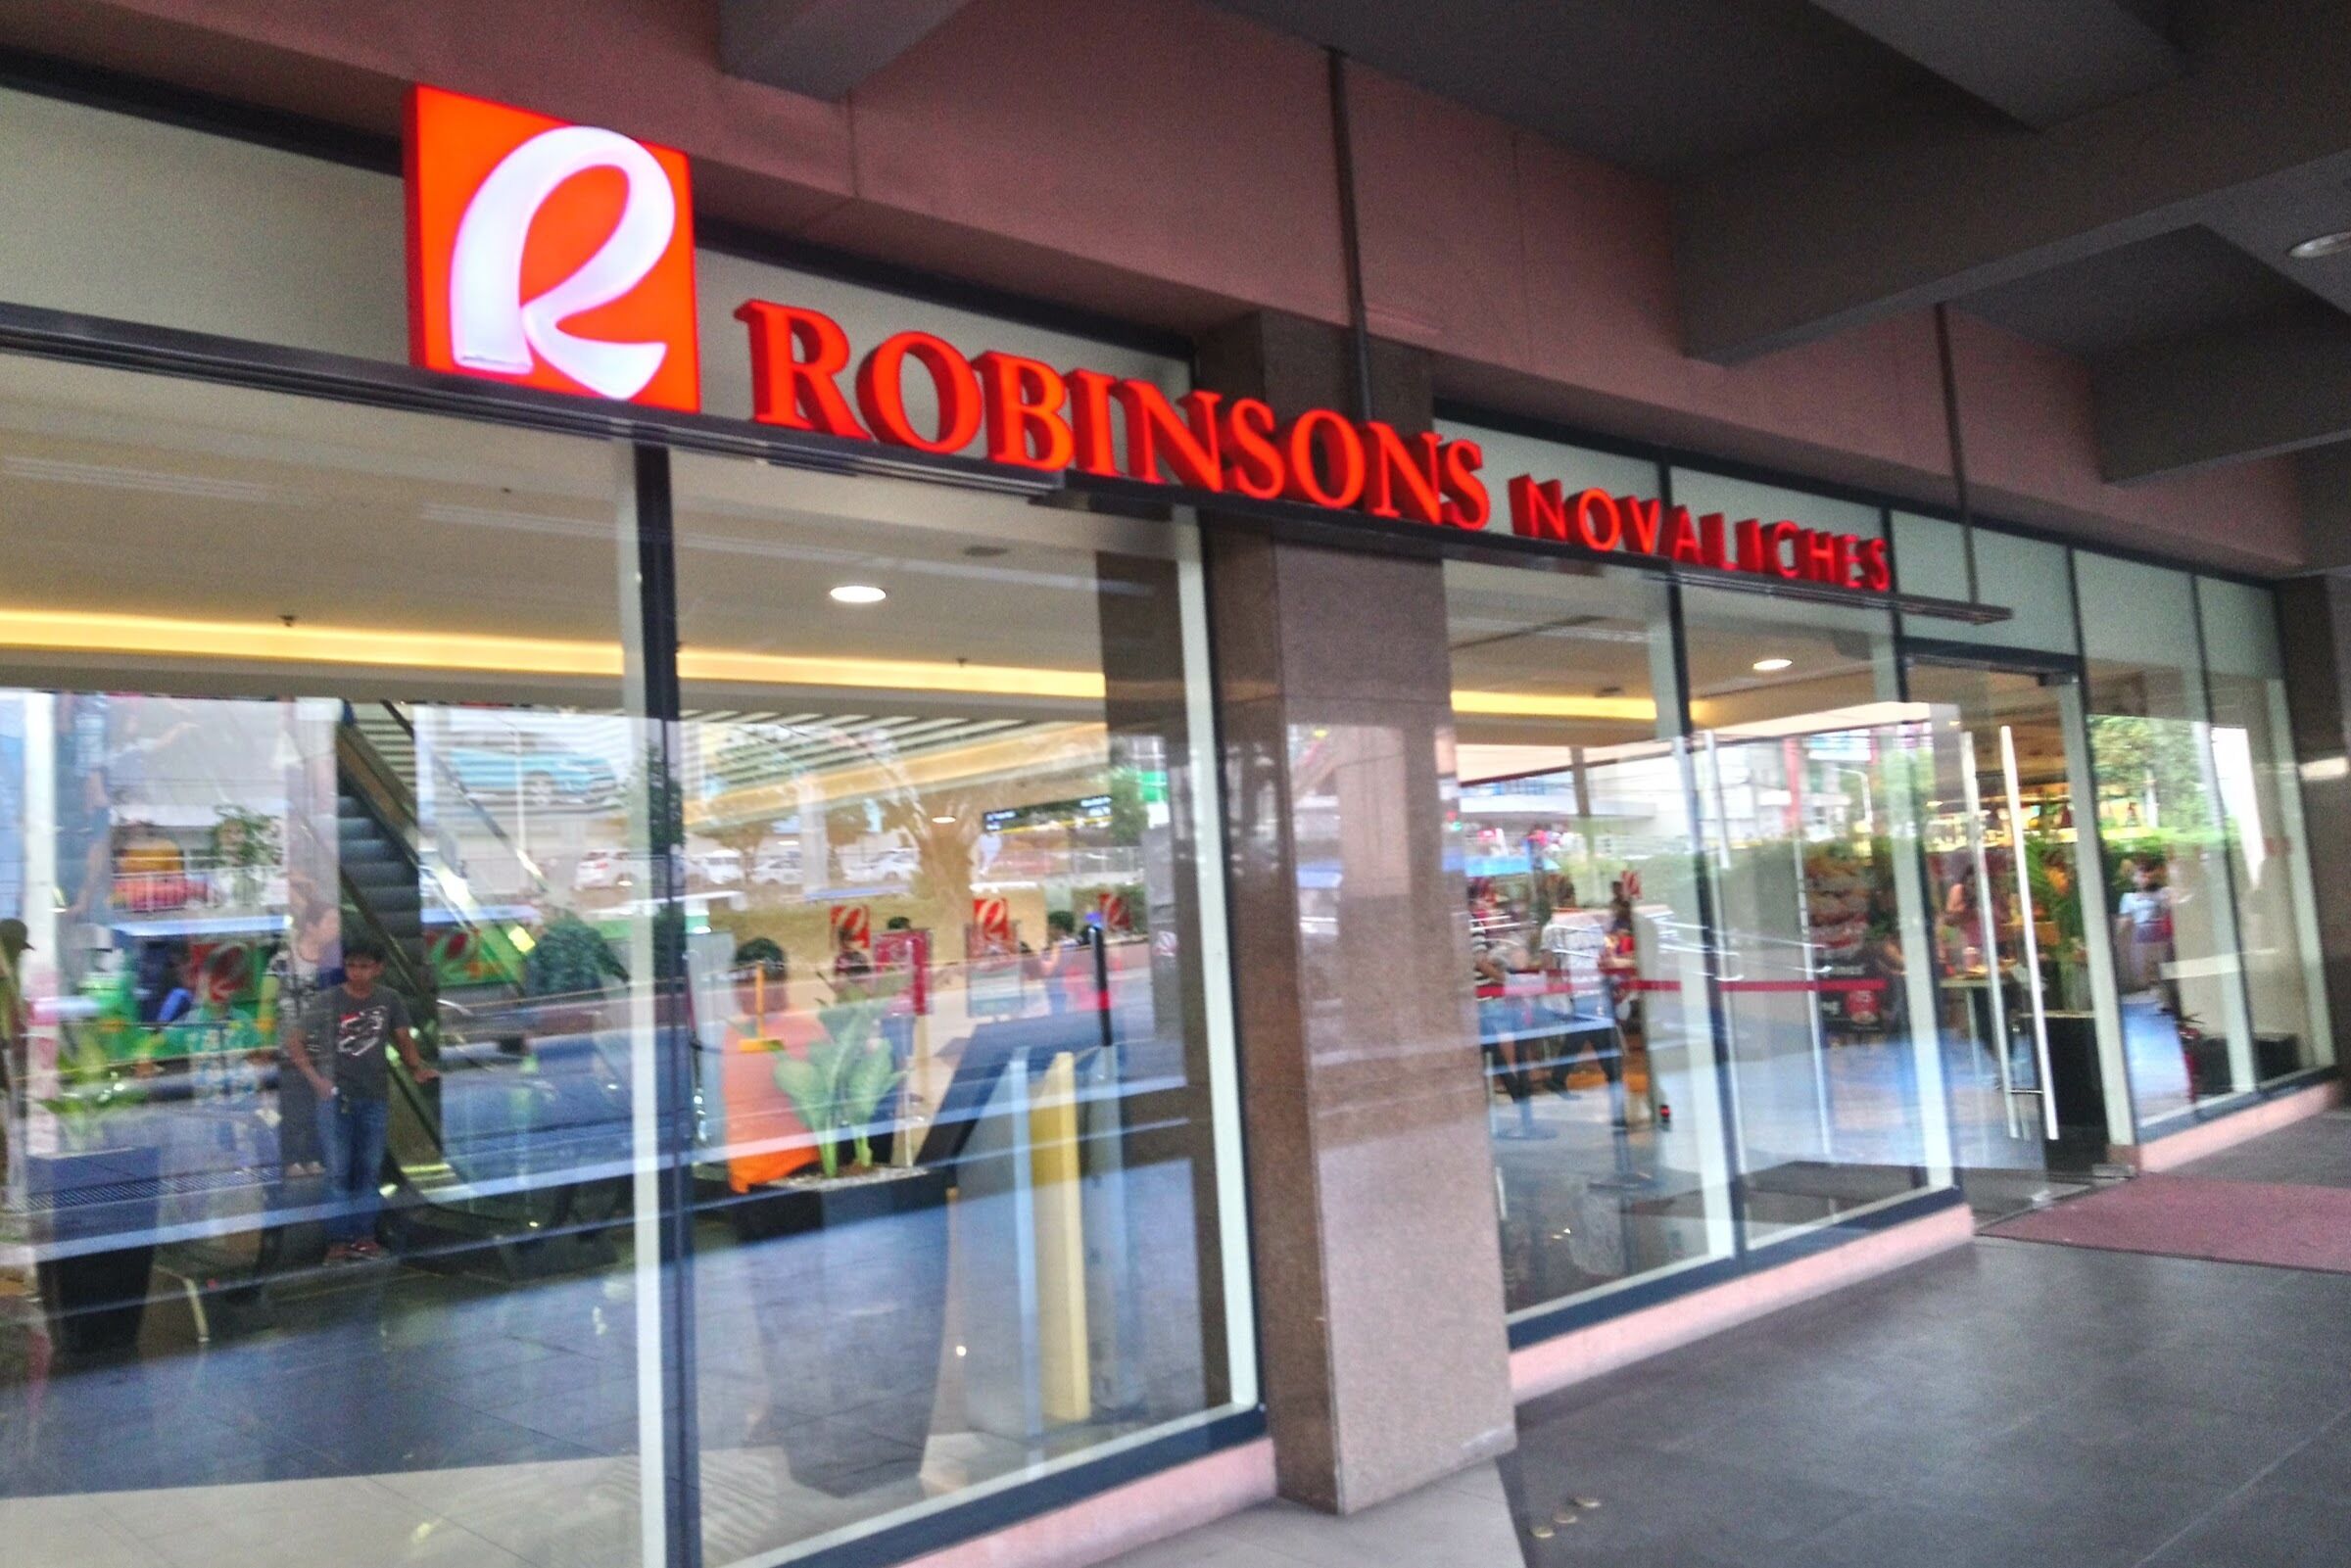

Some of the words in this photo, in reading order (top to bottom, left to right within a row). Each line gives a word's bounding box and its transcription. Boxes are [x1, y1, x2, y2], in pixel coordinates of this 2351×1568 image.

[450, 125, 677, 401] R
[734, 298, 1492, 533] ROBINSONS
[1508, 473, 1892, 593] NOVALICHES
